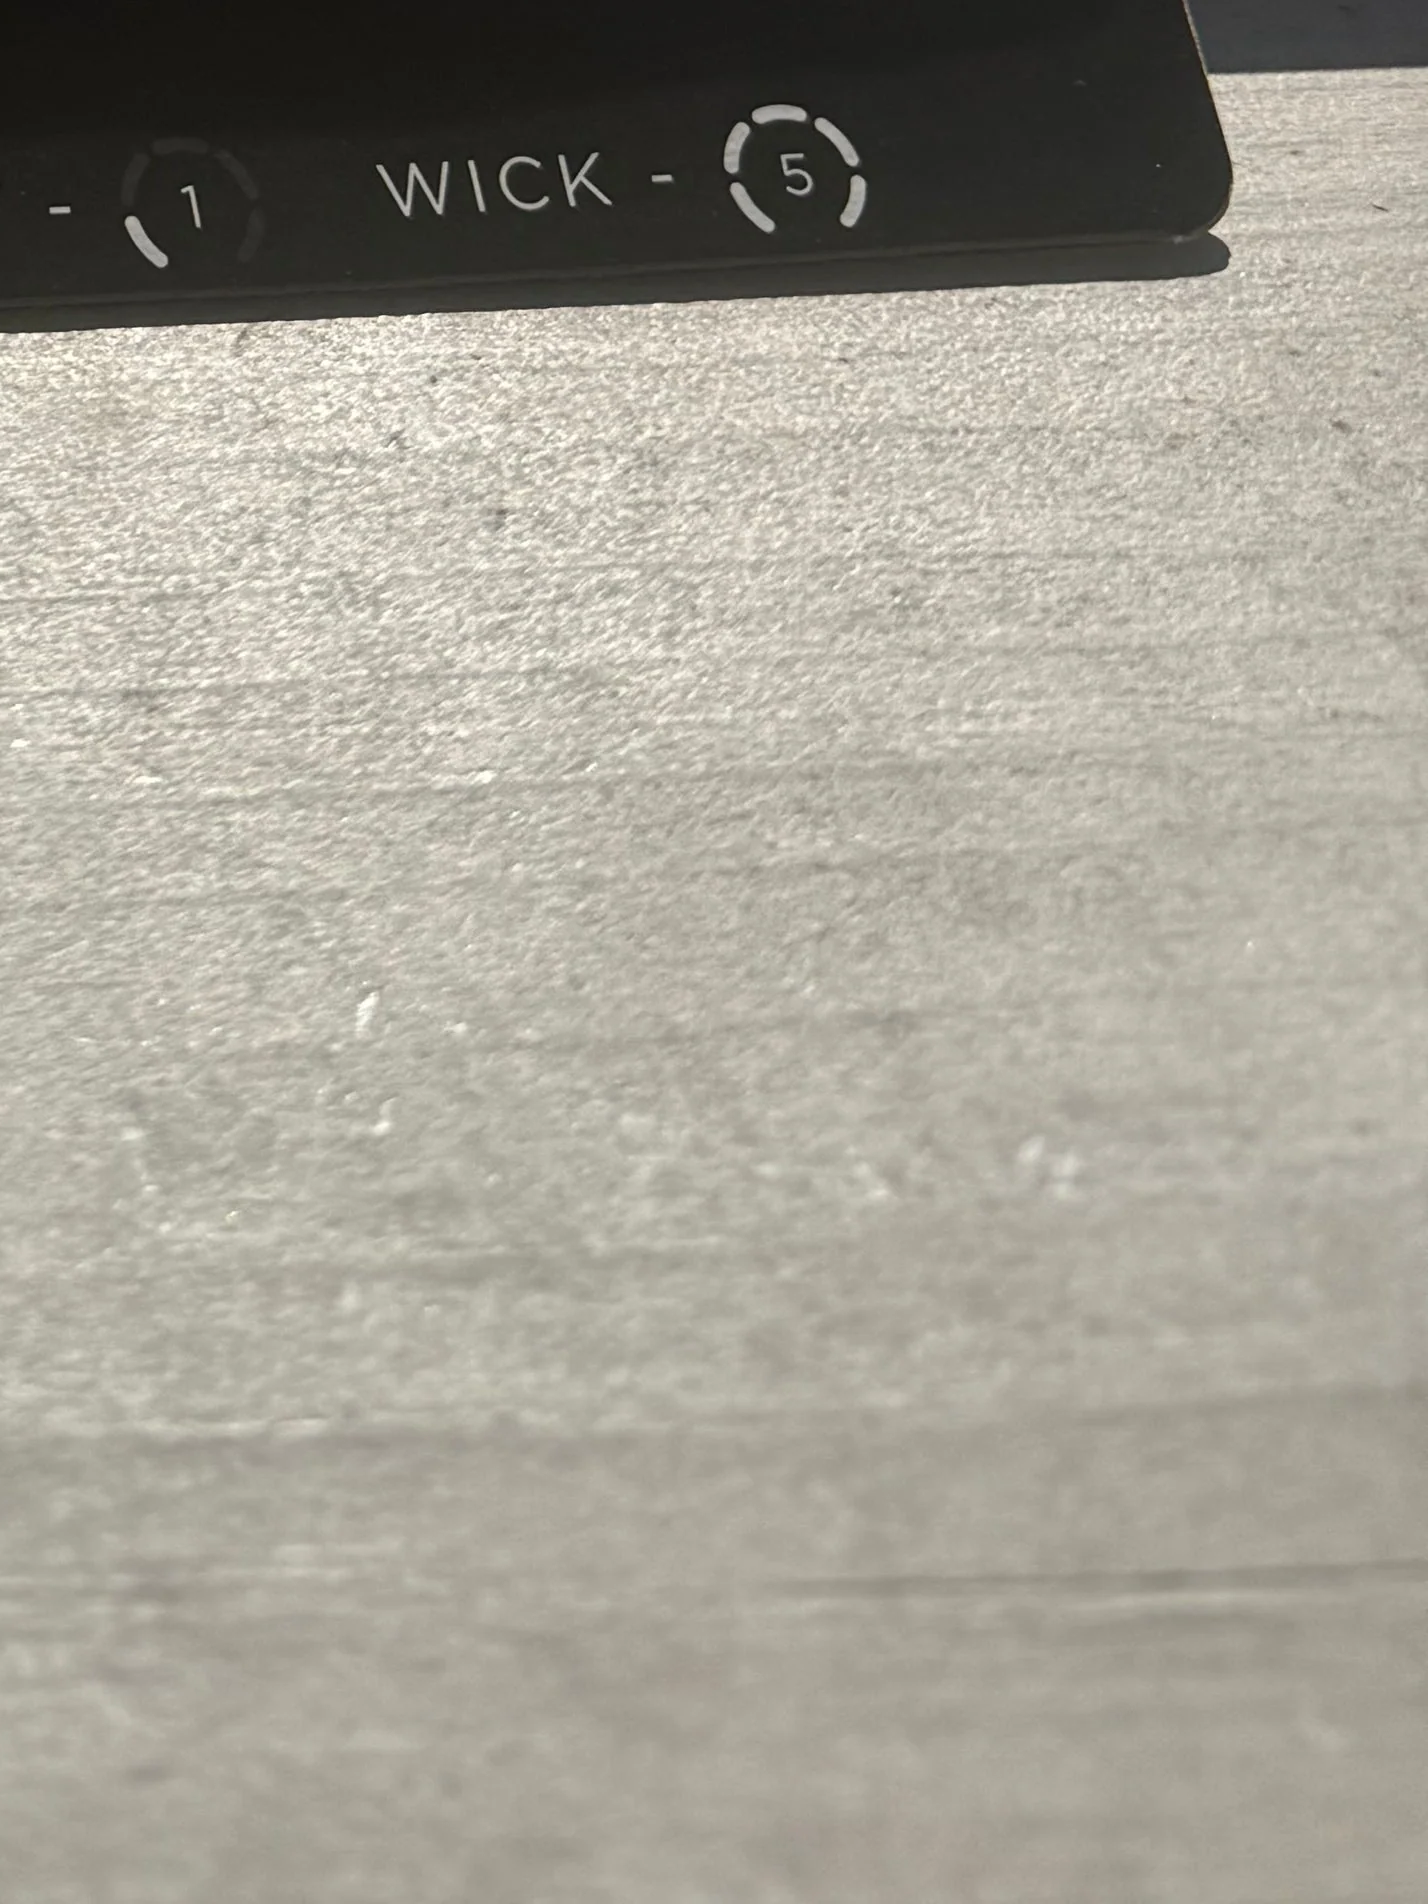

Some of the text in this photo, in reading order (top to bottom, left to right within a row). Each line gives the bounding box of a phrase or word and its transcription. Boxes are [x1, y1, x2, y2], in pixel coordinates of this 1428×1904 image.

[179, 184, 202, 229] 1
[374, 150, 614, 219] WICK
[779, 151, 815, 198] 5
